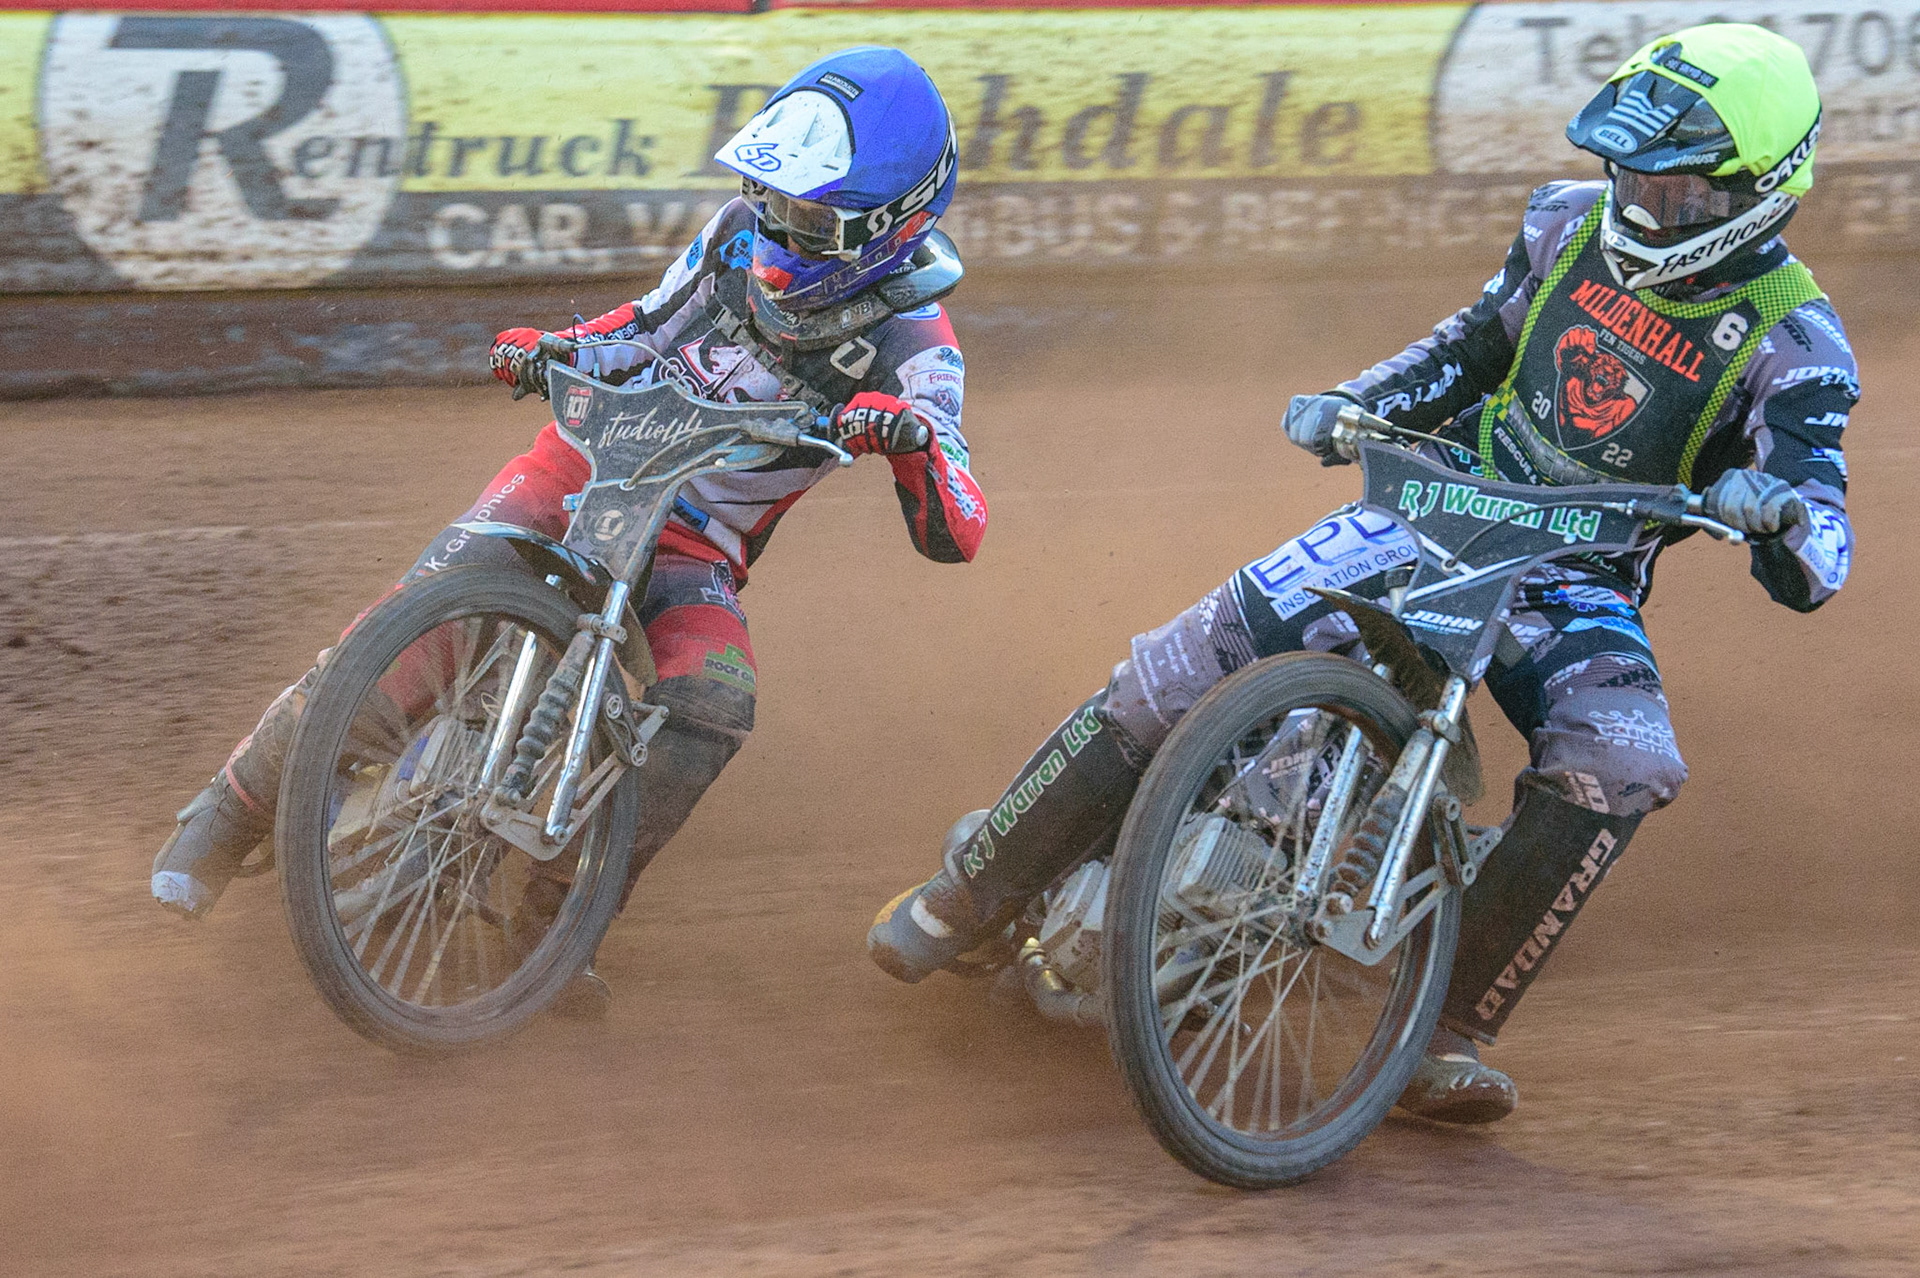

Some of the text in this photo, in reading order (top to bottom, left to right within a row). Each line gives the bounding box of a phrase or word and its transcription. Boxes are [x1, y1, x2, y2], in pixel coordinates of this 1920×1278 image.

[1599, 128, 1631, 149] BELL
[1652, 151, 1720, 172] FASTHOUSE
[1755, 112, 1822, 193] OAKLE
[1569, 279, 1705, 382] MILDENHALL
[1599, 330, 1647, 365] FEN TIGERS
[1711, 311, 1749, 351] 6
[1531, 391, 1551, 420] 20
[1493, 426, 1537, 485] RESCUE &
[1601, 442, 1633, 468] 22
[423, 472, 526, 574] K-Grphics
[1442, 483, 1545, 530] Warren
[1547, 507, 1602, 542] Ltd
[1276, 559, 1372, 615] INSUATION
[1401, 609, 1484, 631] JOHN
[704, 658, 740, 677] ROCK
[990, 749, 1067, 836] Warren
[1061, 706, 1103, 757] Ltd
[1475, 828, 1618, 1020] GRANDAD
